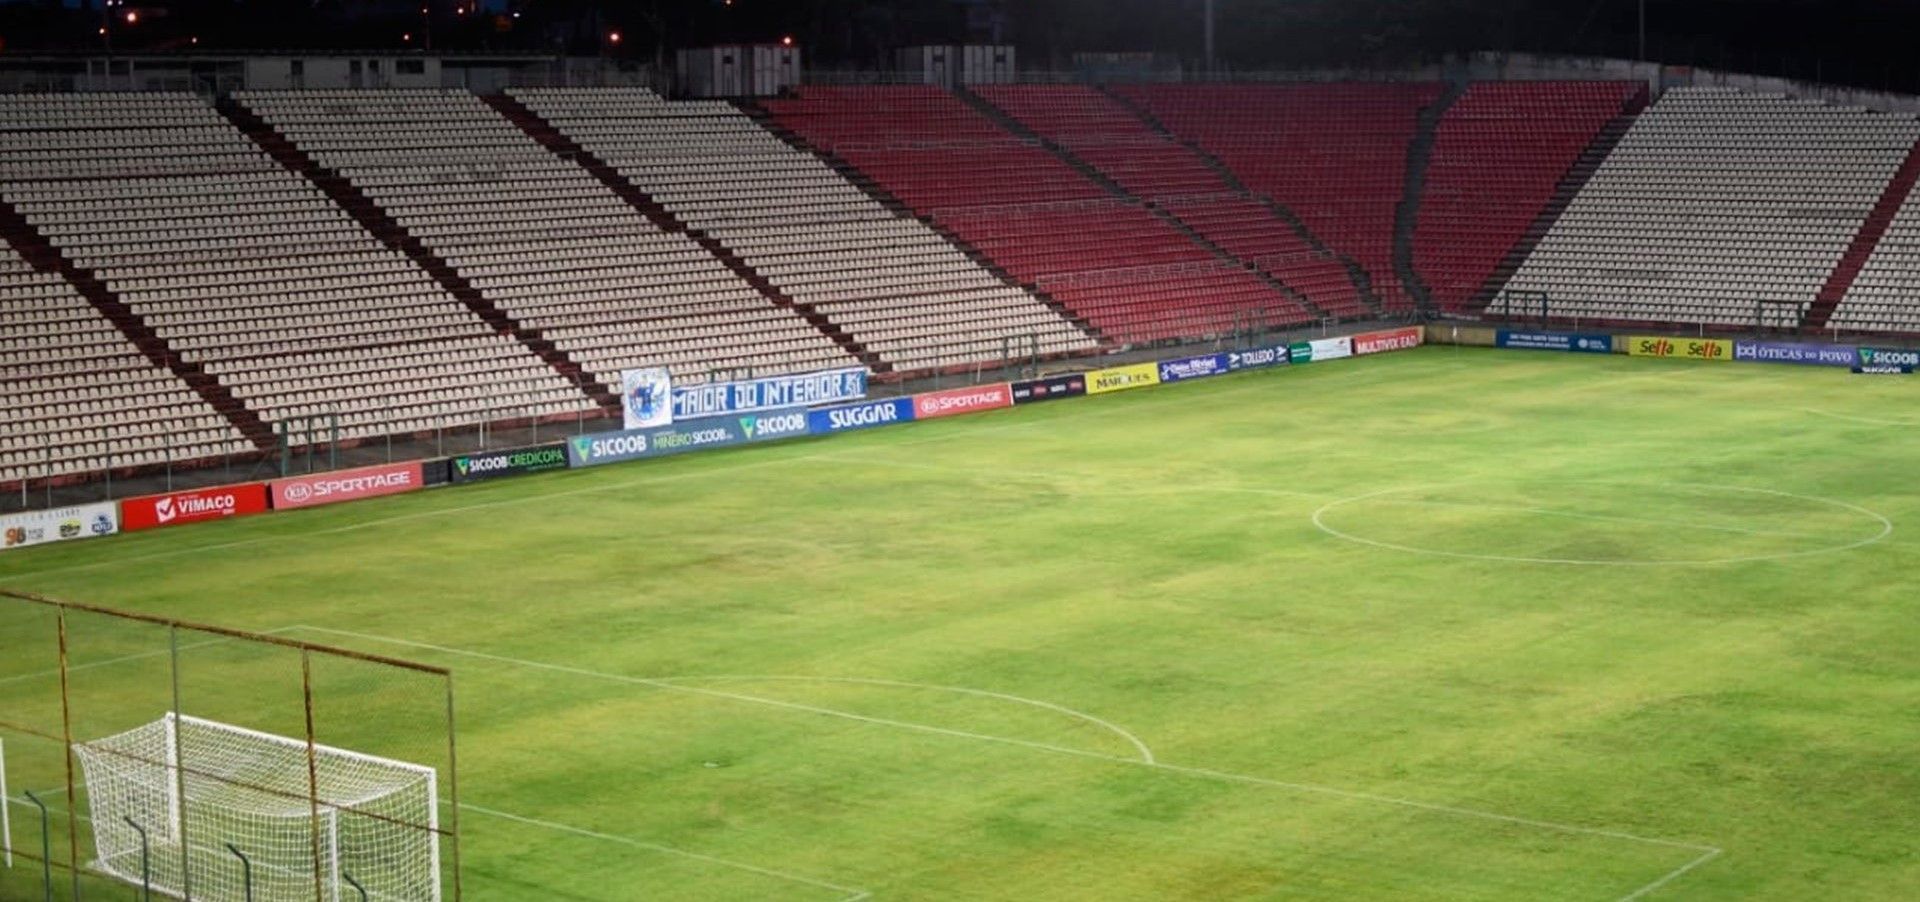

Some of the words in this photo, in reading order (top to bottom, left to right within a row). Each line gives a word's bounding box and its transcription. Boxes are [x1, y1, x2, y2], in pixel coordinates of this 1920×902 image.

[1819, 351, 1852, 362] POVO
[1873, 351, 1919, 365] SICOOB
[672, 387, 727, 416] MAIOR
[735, 383, 757, 410] DO
[764, 373, 843, 406] INTERIOR
[939, 391, 1004, 410] SPORTAGE
[756, 414, 806, 435] SICOOB
[829, 403, 897, 429] SUGGAR
[592, 435, 647, 457] SICOOB
[692, 429, 726, 445] SICOOB
[313, 471, 411, 496] SPORTAGE
[177, 494, 236, 513] VIMACO
